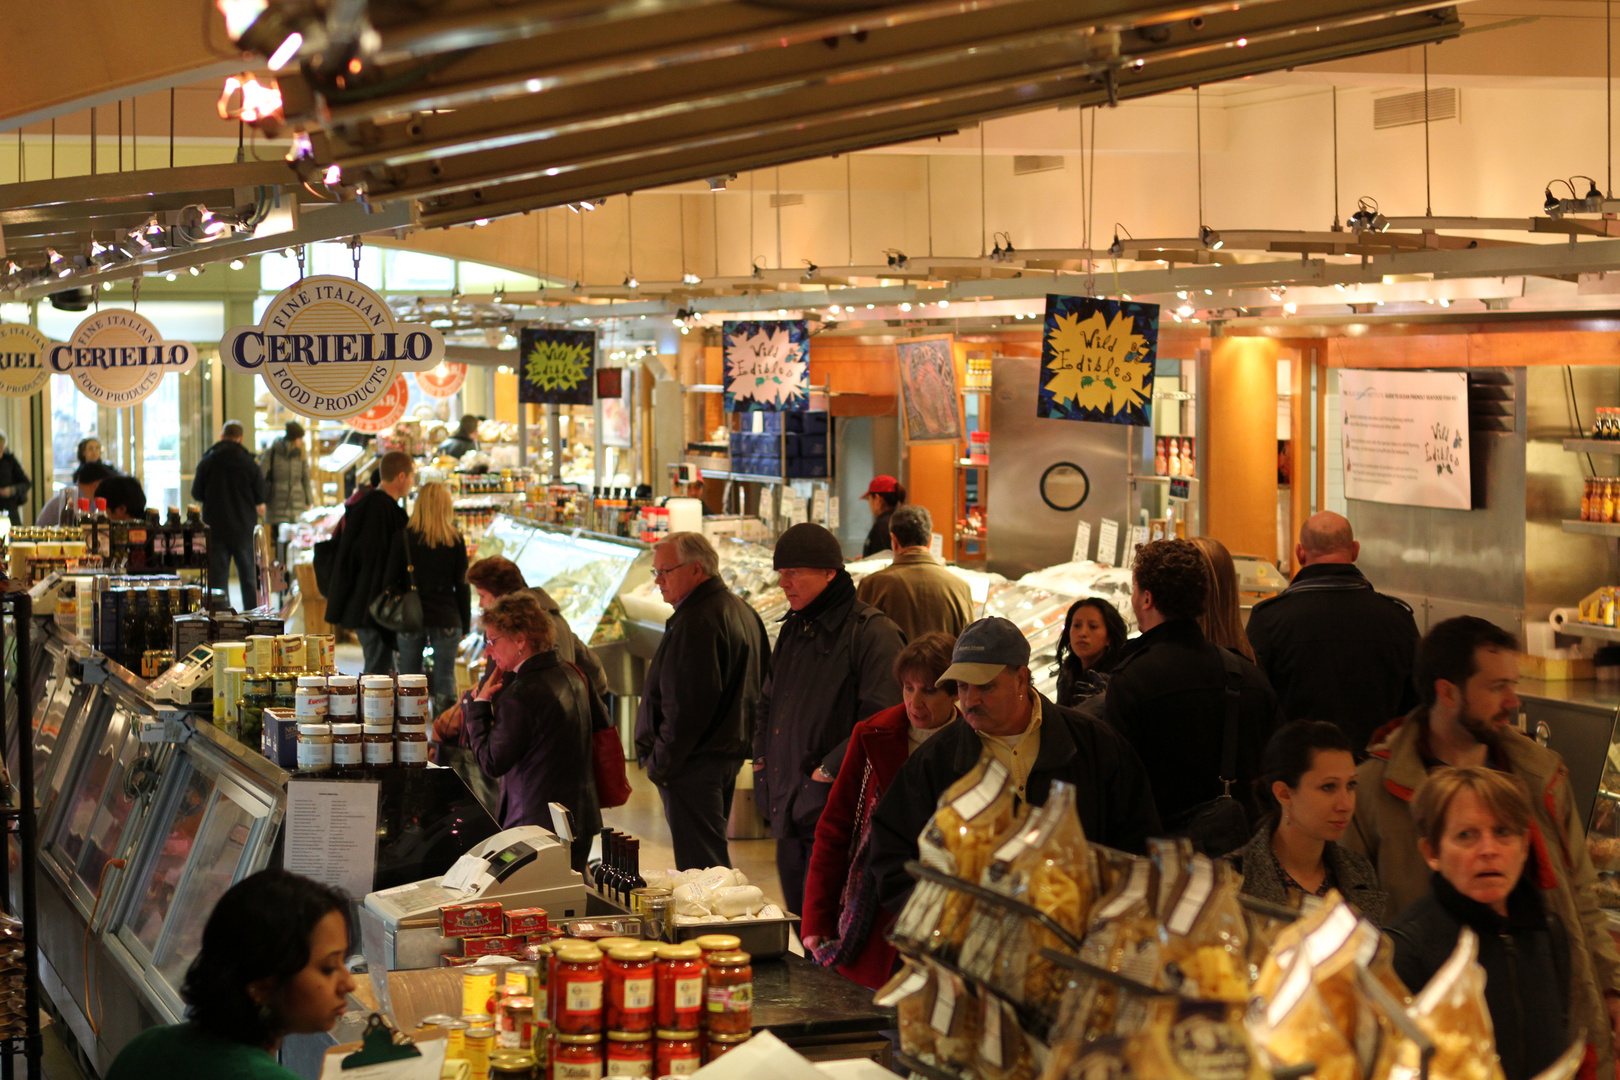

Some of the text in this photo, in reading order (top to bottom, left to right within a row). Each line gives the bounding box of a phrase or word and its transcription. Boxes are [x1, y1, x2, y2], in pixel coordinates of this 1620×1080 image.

[272, 285, 386, 330] FINE ITALIAN
[78, 315, 156, 346] FINE ITALIAN
[1080, 328, 1118, 353] Wild
[49, 344, 189, 372] CERIELLO
[231, 330, 433, 369] CERIELLO
[749, 342, 779, 358] Wild
[1055, 348, 1133, 382] Edibles
[736, 359, 793, 377] Edibles
[78, 370, 158, 402] FOOD PRODUCTS
[272, 365, 388, 411] FOOD PRODUCTS
[1431, 422, 1450, 442] Wild
